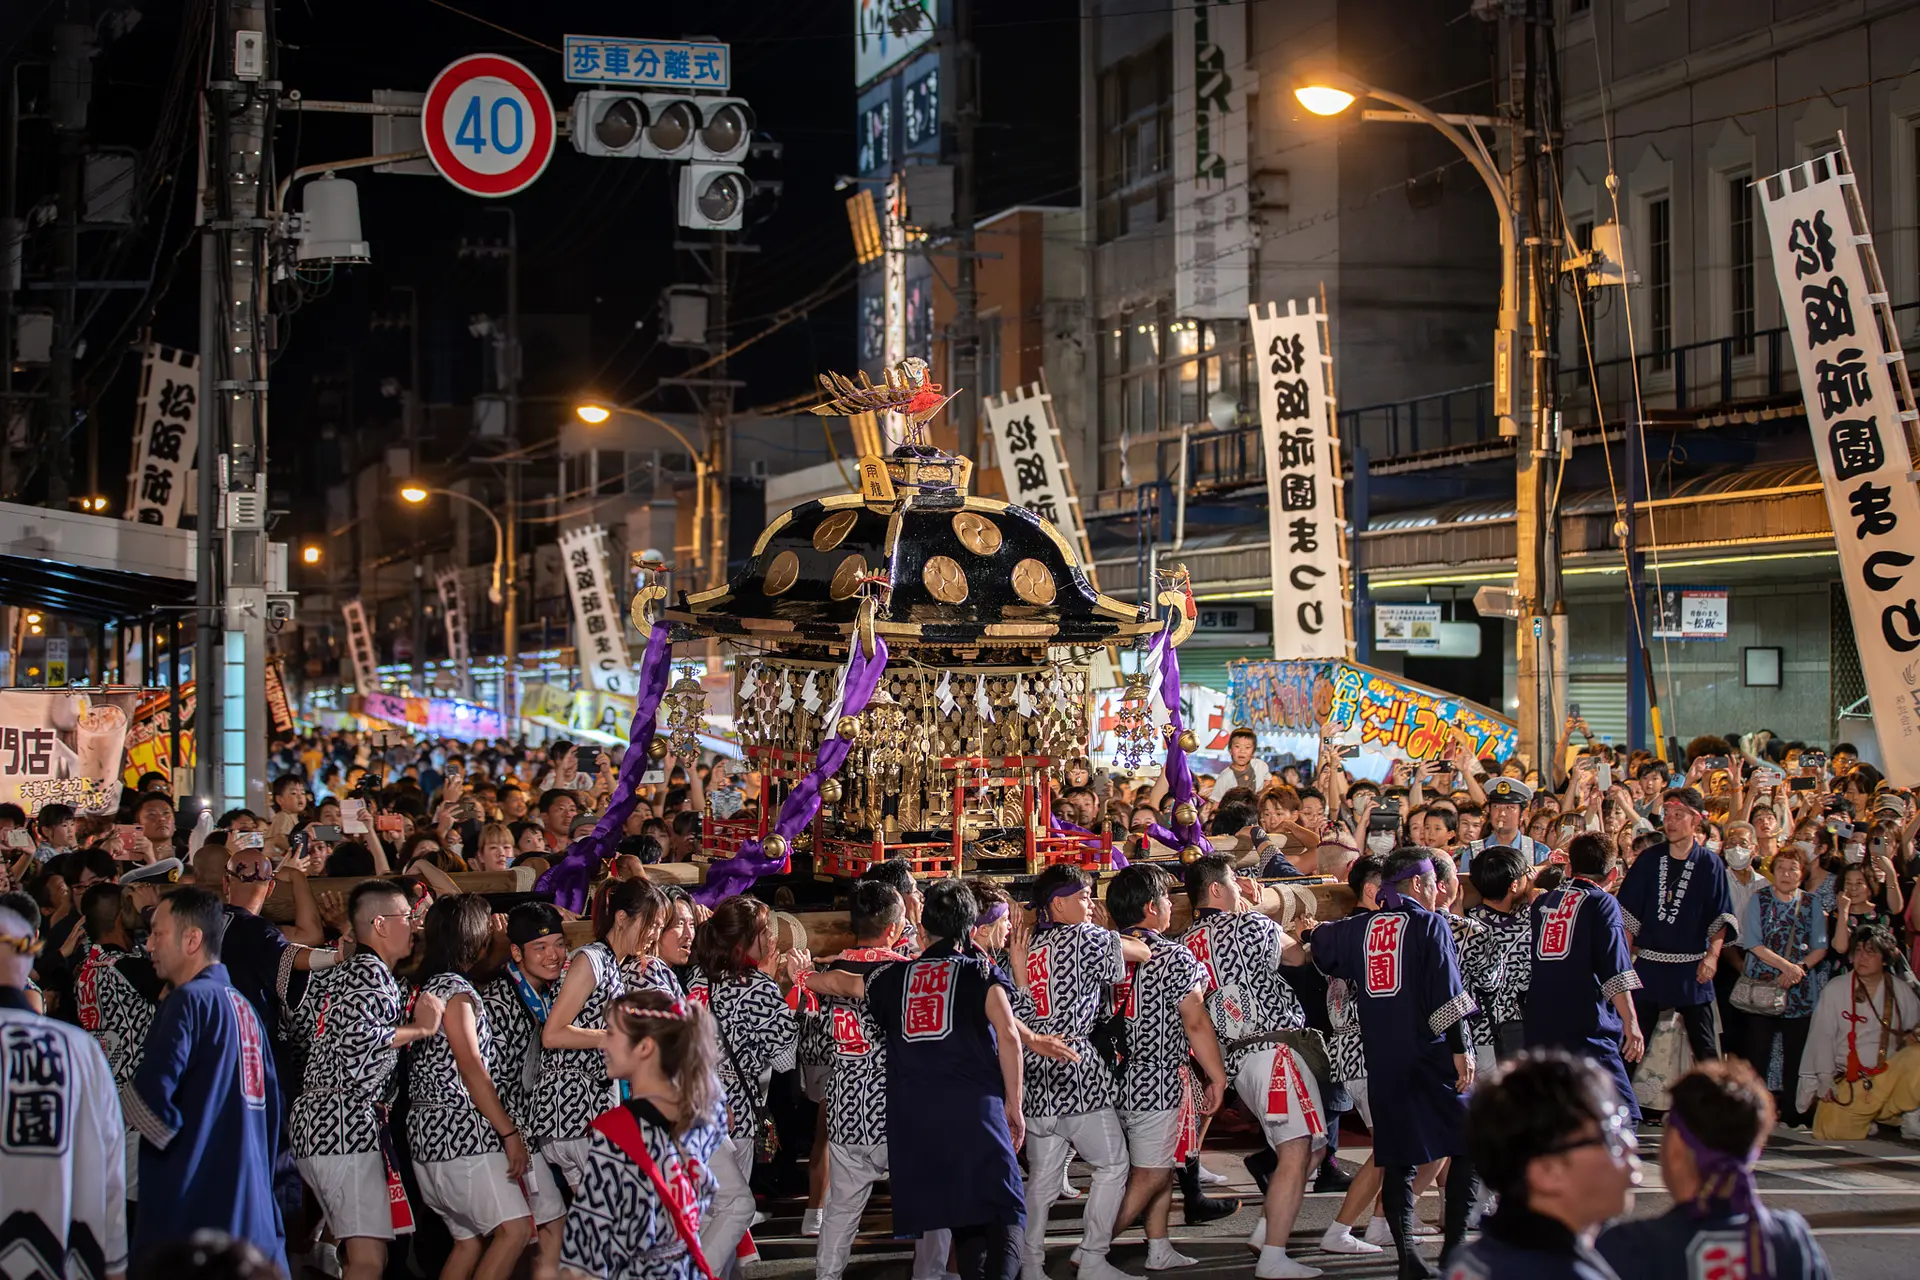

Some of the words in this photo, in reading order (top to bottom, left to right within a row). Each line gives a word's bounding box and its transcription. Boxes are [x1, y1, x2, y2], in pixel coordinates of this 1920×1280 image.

[573, 46, 720, 81] 歩車分離式
[455, 96, 523, 155] 40
[1360, 696, 1408, 724] シャリ
[1361, 720, 1410, 748] シャリ
[1186, 929, 1218, 998] 祇
[1368, 918, 1401, 991] 祇園
[905, 961, 950, 1034] 祇園
[6, 1030, 66, 1146] 祇園
